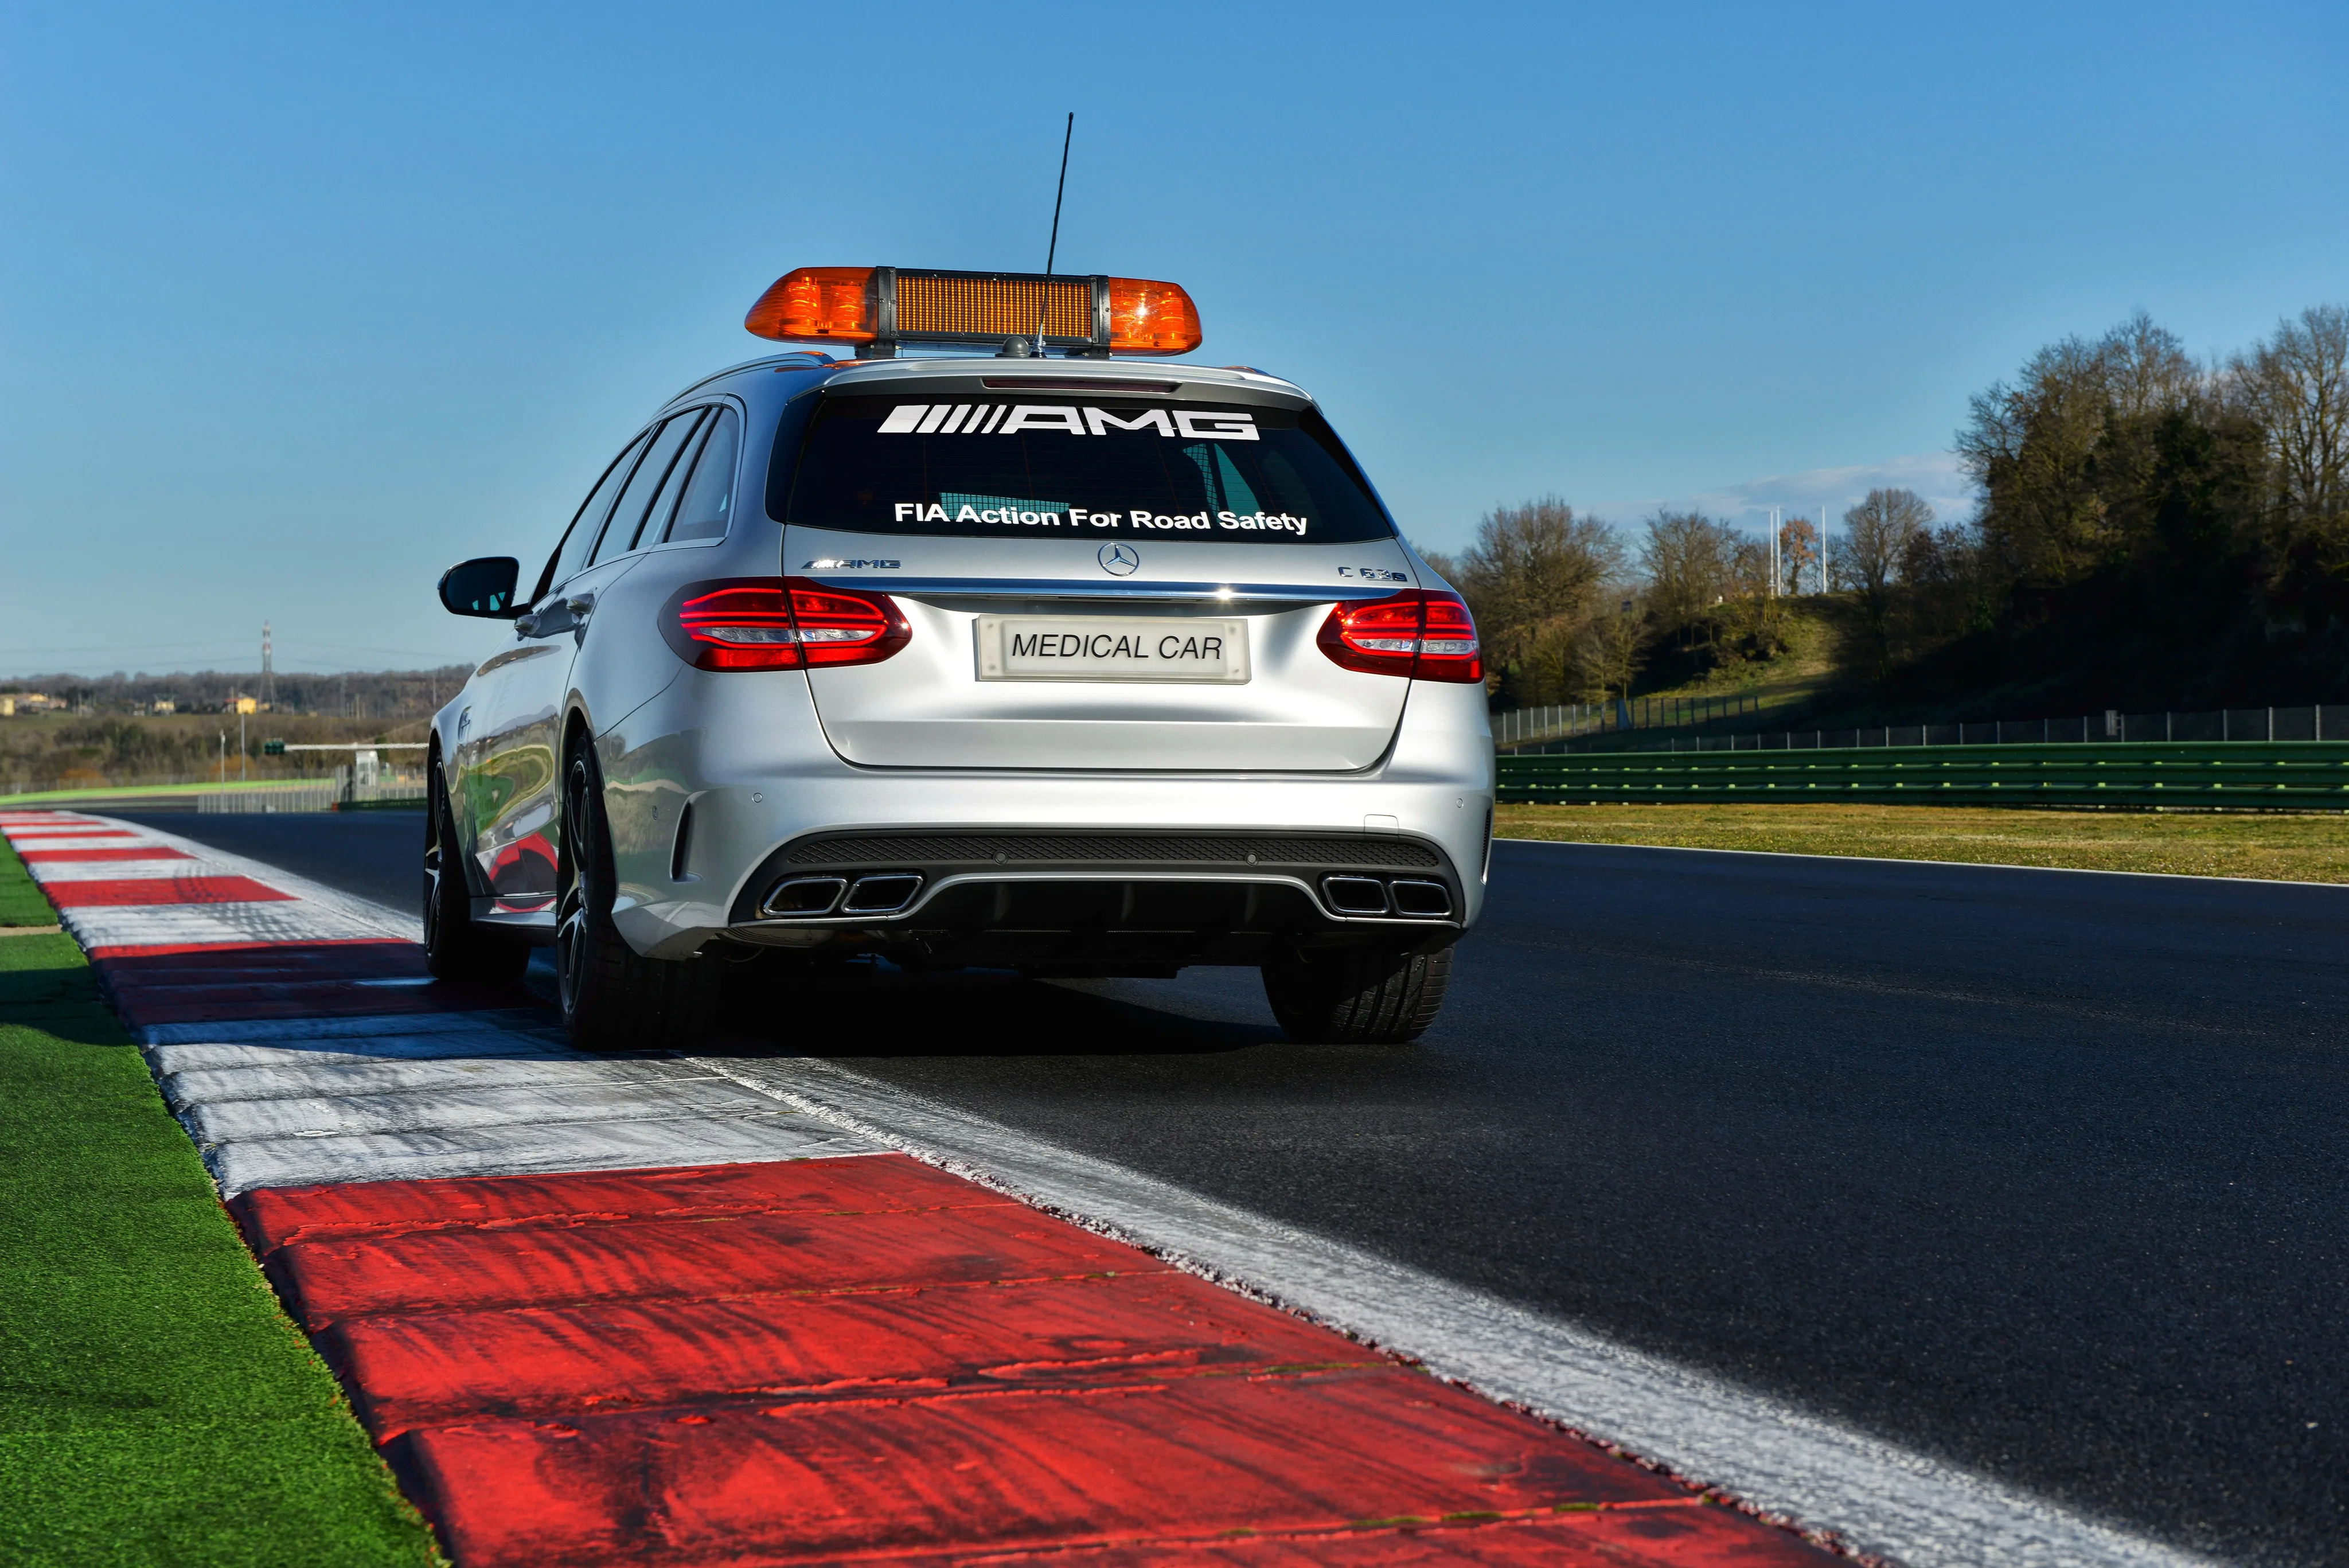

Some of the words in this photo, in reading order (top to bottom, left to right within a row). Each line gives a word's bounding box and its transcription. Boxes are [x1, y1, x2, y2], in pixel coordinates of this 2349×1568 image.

[998, 405, 1260, 440] AMG
[895, 504, 950, 522] FIA
[955, 505, 1060, 525] Action
[1069, 509, 1122, 527] For
[1130, 510, 1211, 529] Road
[1218, 511, 1307, 535] Safety
[1338, 567, 1353, 578] C
[1012, 634, 1149, 658] MEDICAL
[1158, 636, 1222, 659] CAR
